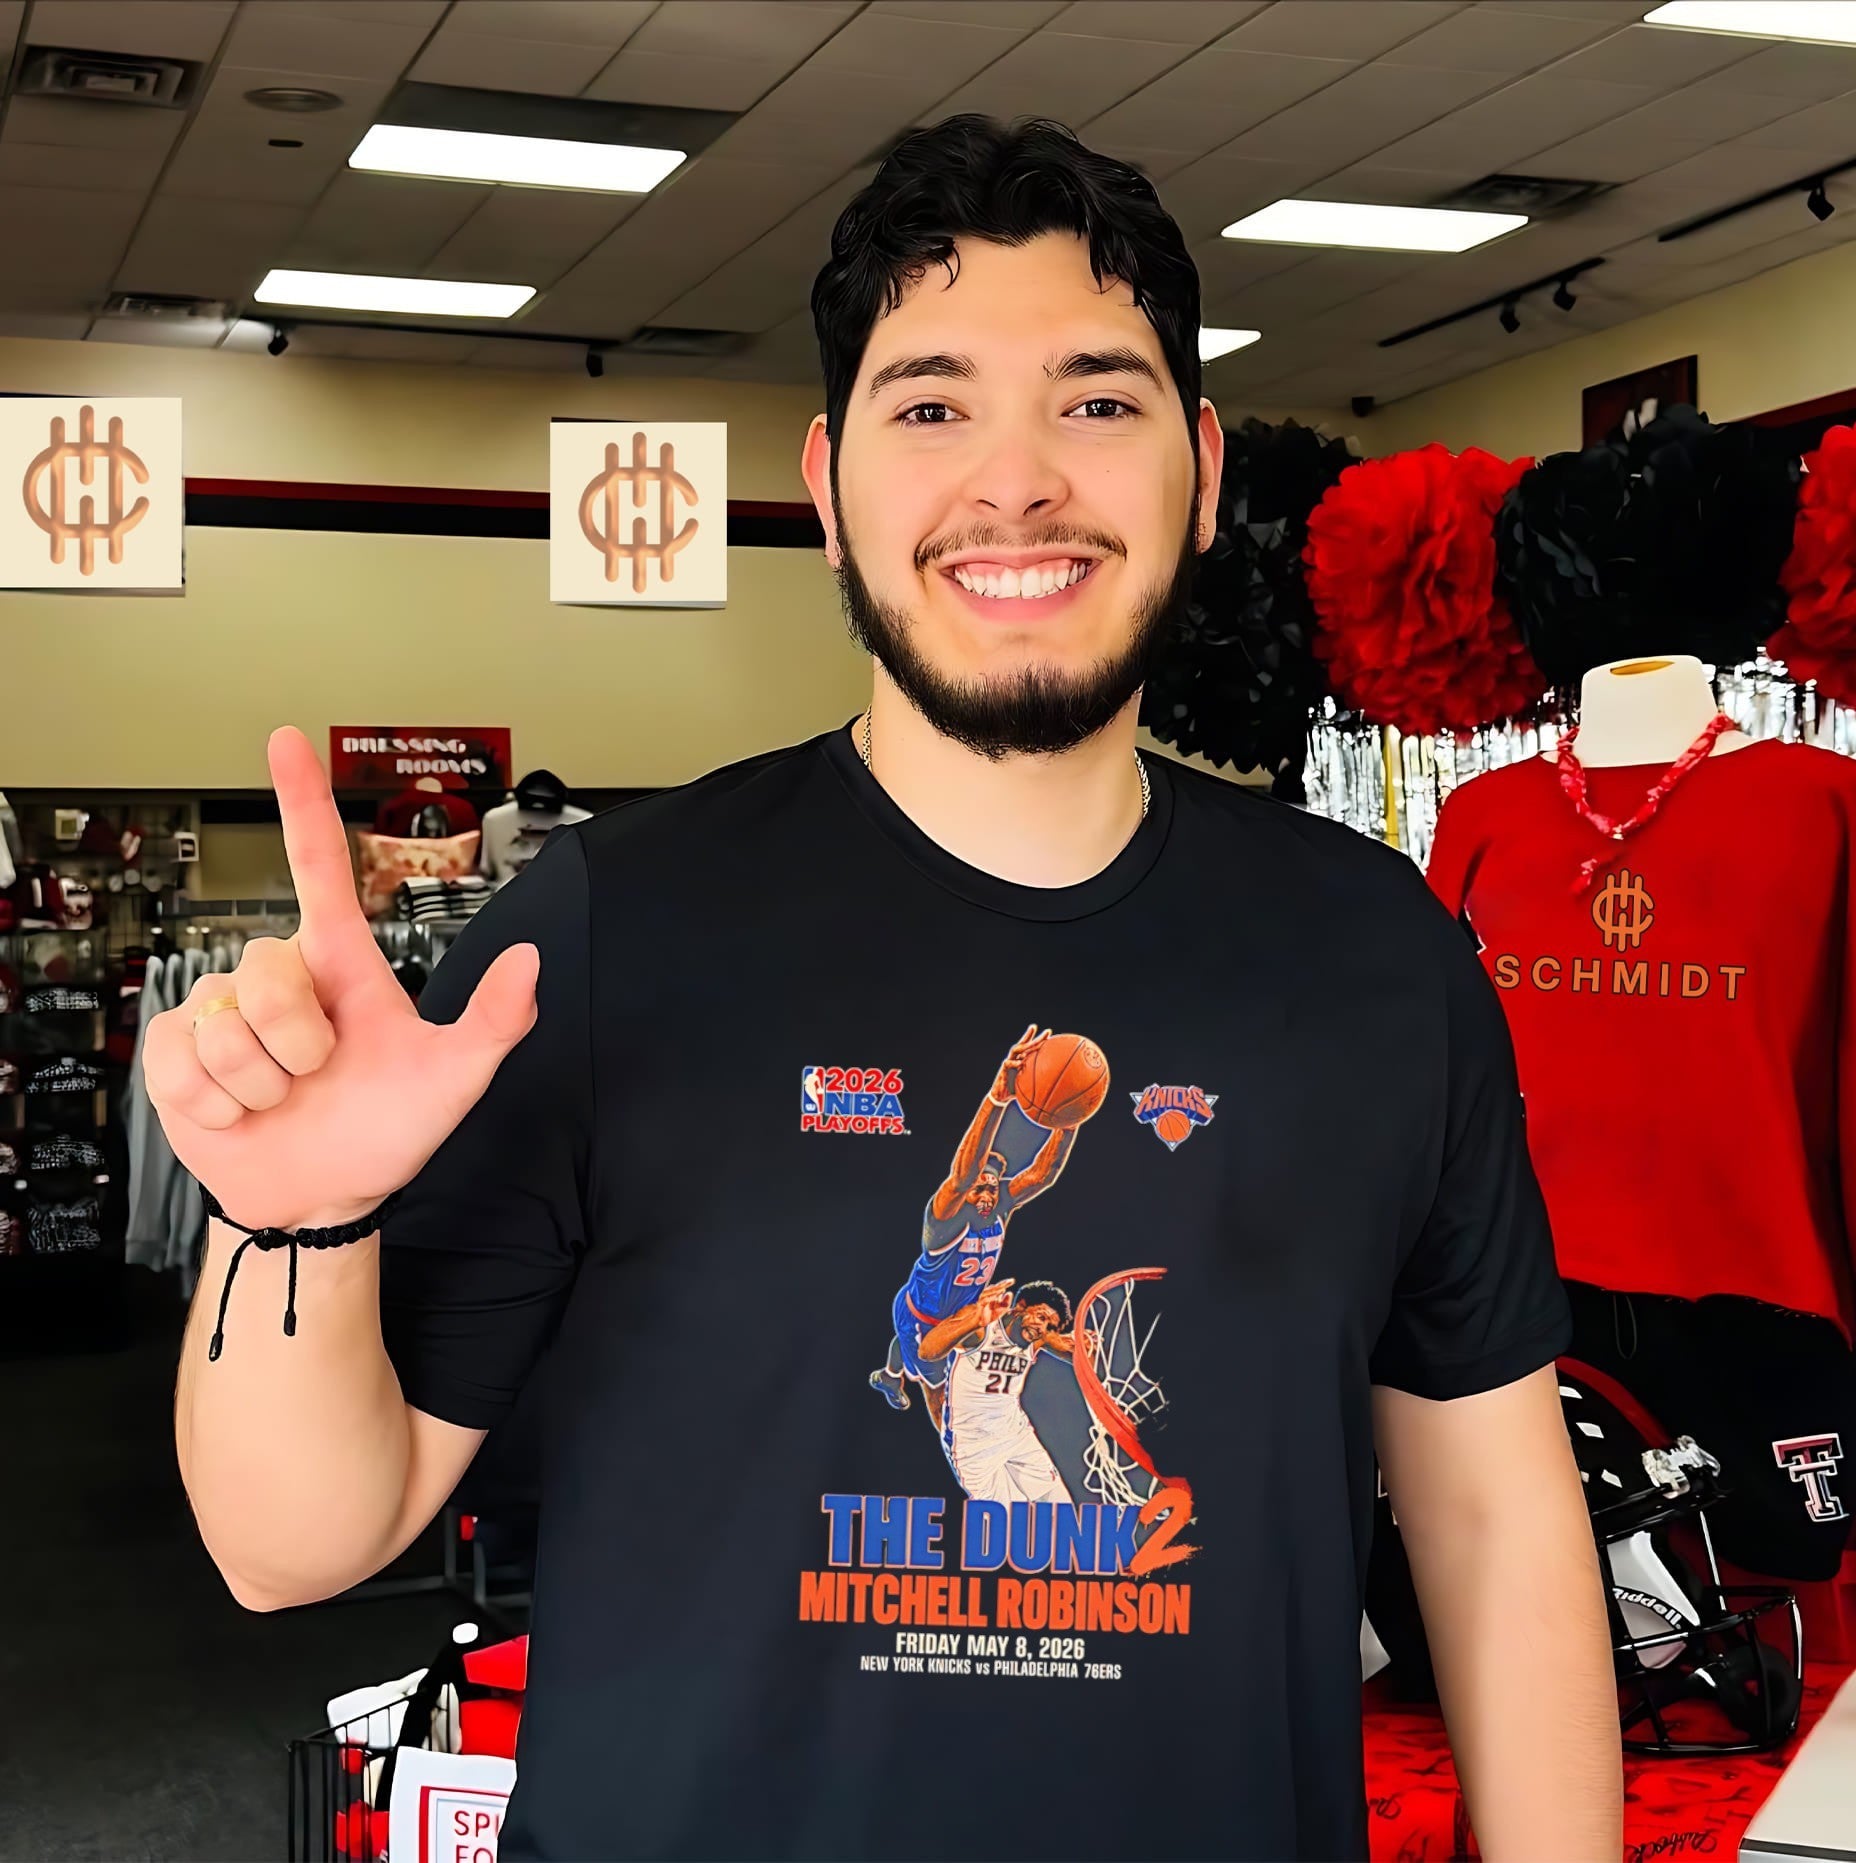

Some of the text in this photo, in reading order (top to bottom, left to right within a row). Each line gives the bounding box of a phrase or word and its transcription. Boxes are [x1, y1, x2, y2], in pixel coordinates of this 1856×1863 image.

[396, 758, 487, 775] ROOMS
[1494, 954, 1747, 1000] SCHMIDT
[825, 1066, 904, 1095] 2026
[825, 1092, 904, 1117] NBA
[1136, 1085, 1213, 1120] KNICKS
[801, 1114, 905, 1135] PLAYOFFS
[953, 1256, 996, 1286] 23
[985, 1373, 1012, 1394] 21
[821, 1486, 1201, 1578] THE DUNK 2
[799, 1571, 1192, 1635] MITCHELL ROBINSON
[895, 1631, 1086, 1661] FRIDAY MAY 8, 2026
[860, 1655, 890, 1672] NEW
[892, 1656, 924, 1674] YORK
[927, 1657, 972, 1675] KNICKS
[994, 1660, 1079, 1679] PHILADELPHIA
[1083, 1661, 1122, 1680] 76ERS
